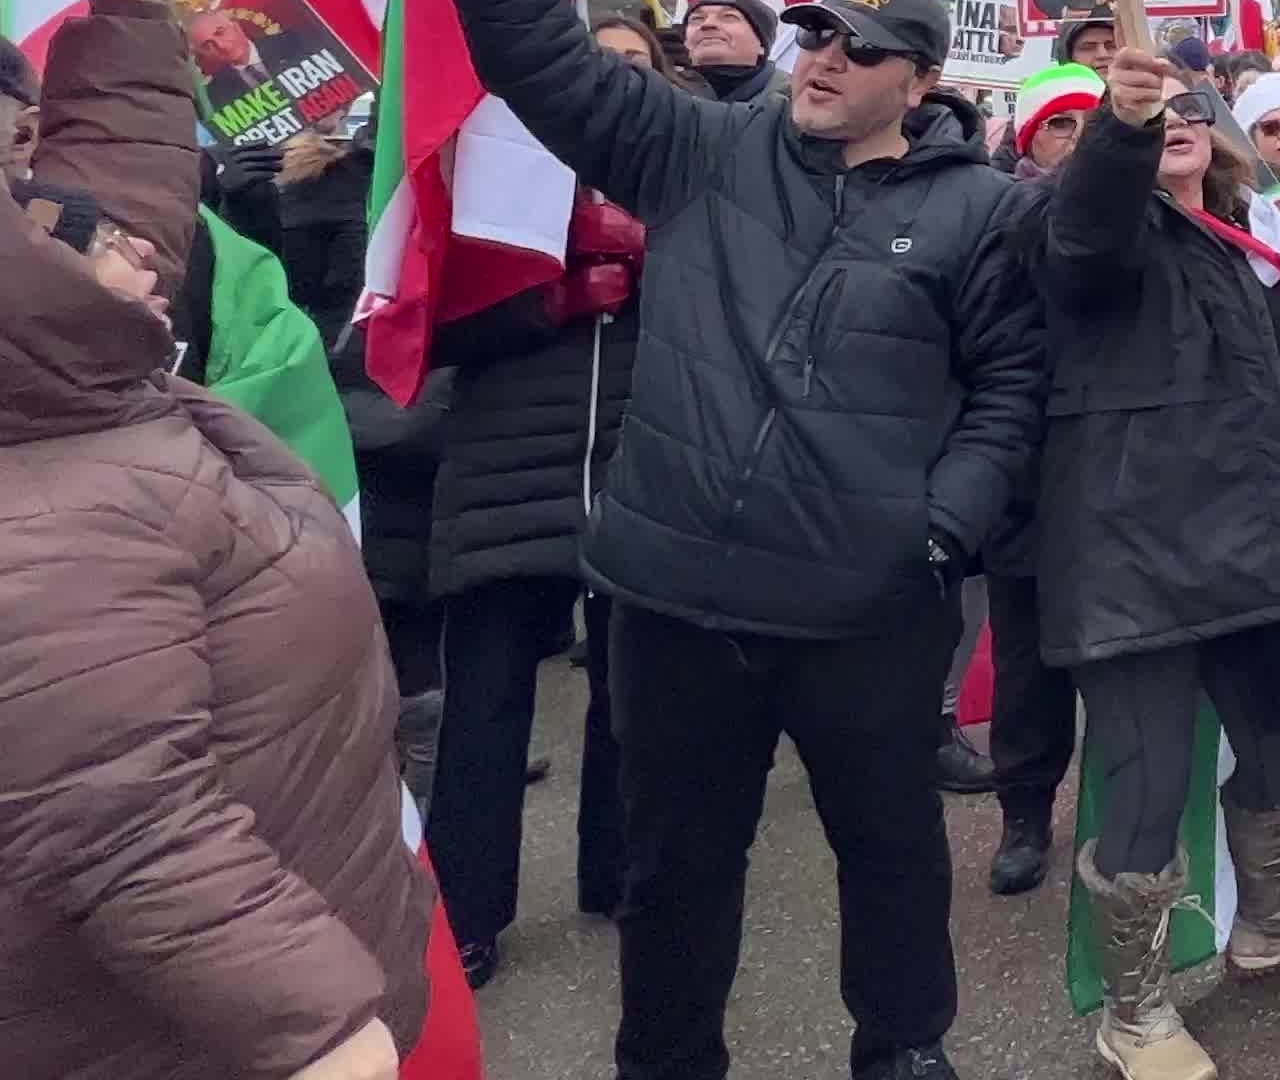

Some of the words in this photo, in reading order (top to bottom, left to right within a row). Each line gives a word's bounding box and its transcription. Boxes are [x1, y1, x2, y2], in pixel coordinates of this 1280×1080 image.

[956, 0, 996, 30] INA
[951, 30, 999, 53] ATTL
[212, 80, 290, 137] MAKE
[276, 48, 346, 99] IRAN
[297, 73, 359, 122] AGAIN
